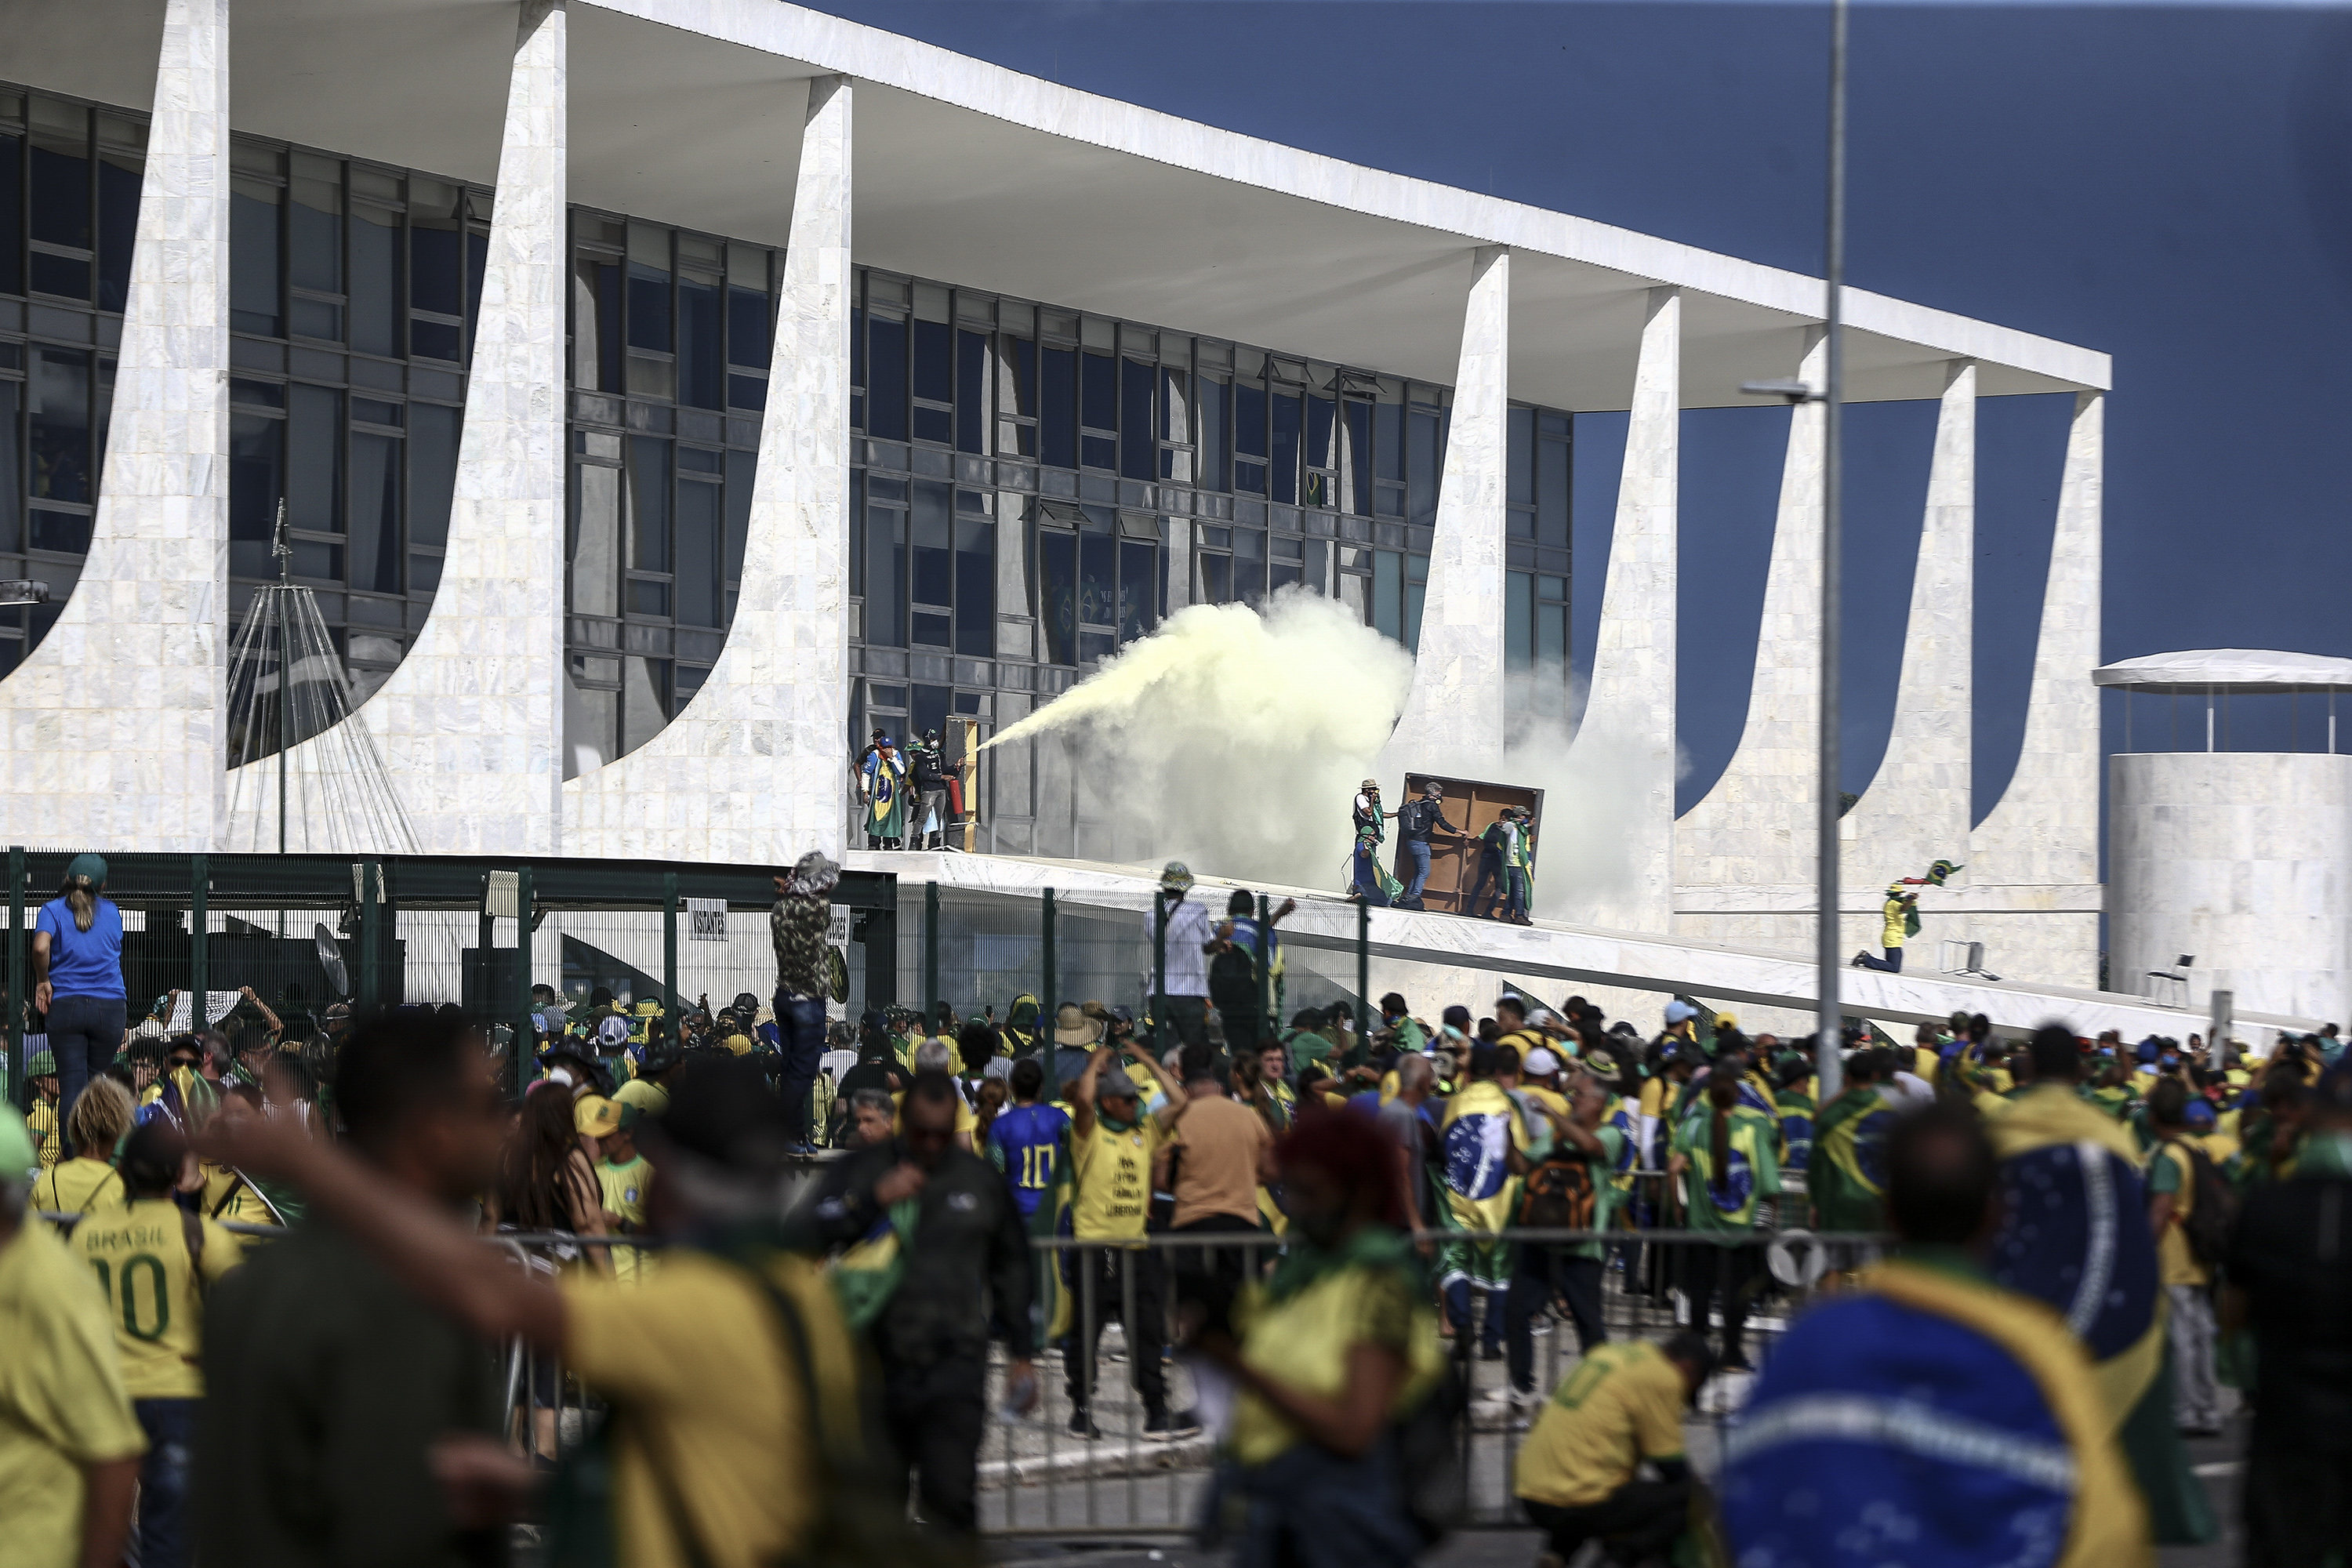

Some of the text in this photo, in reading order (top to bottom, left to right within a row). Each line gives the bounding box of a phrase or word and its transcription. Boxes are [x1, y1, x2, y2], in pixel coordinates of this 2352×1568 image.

[691, 910, 724, 935] VISITANTES
[826, 916, 847, 940] DORES
[1018, 1142, 1057, 1189] 10
[86, 1225, 165, 1251] BRASIL
